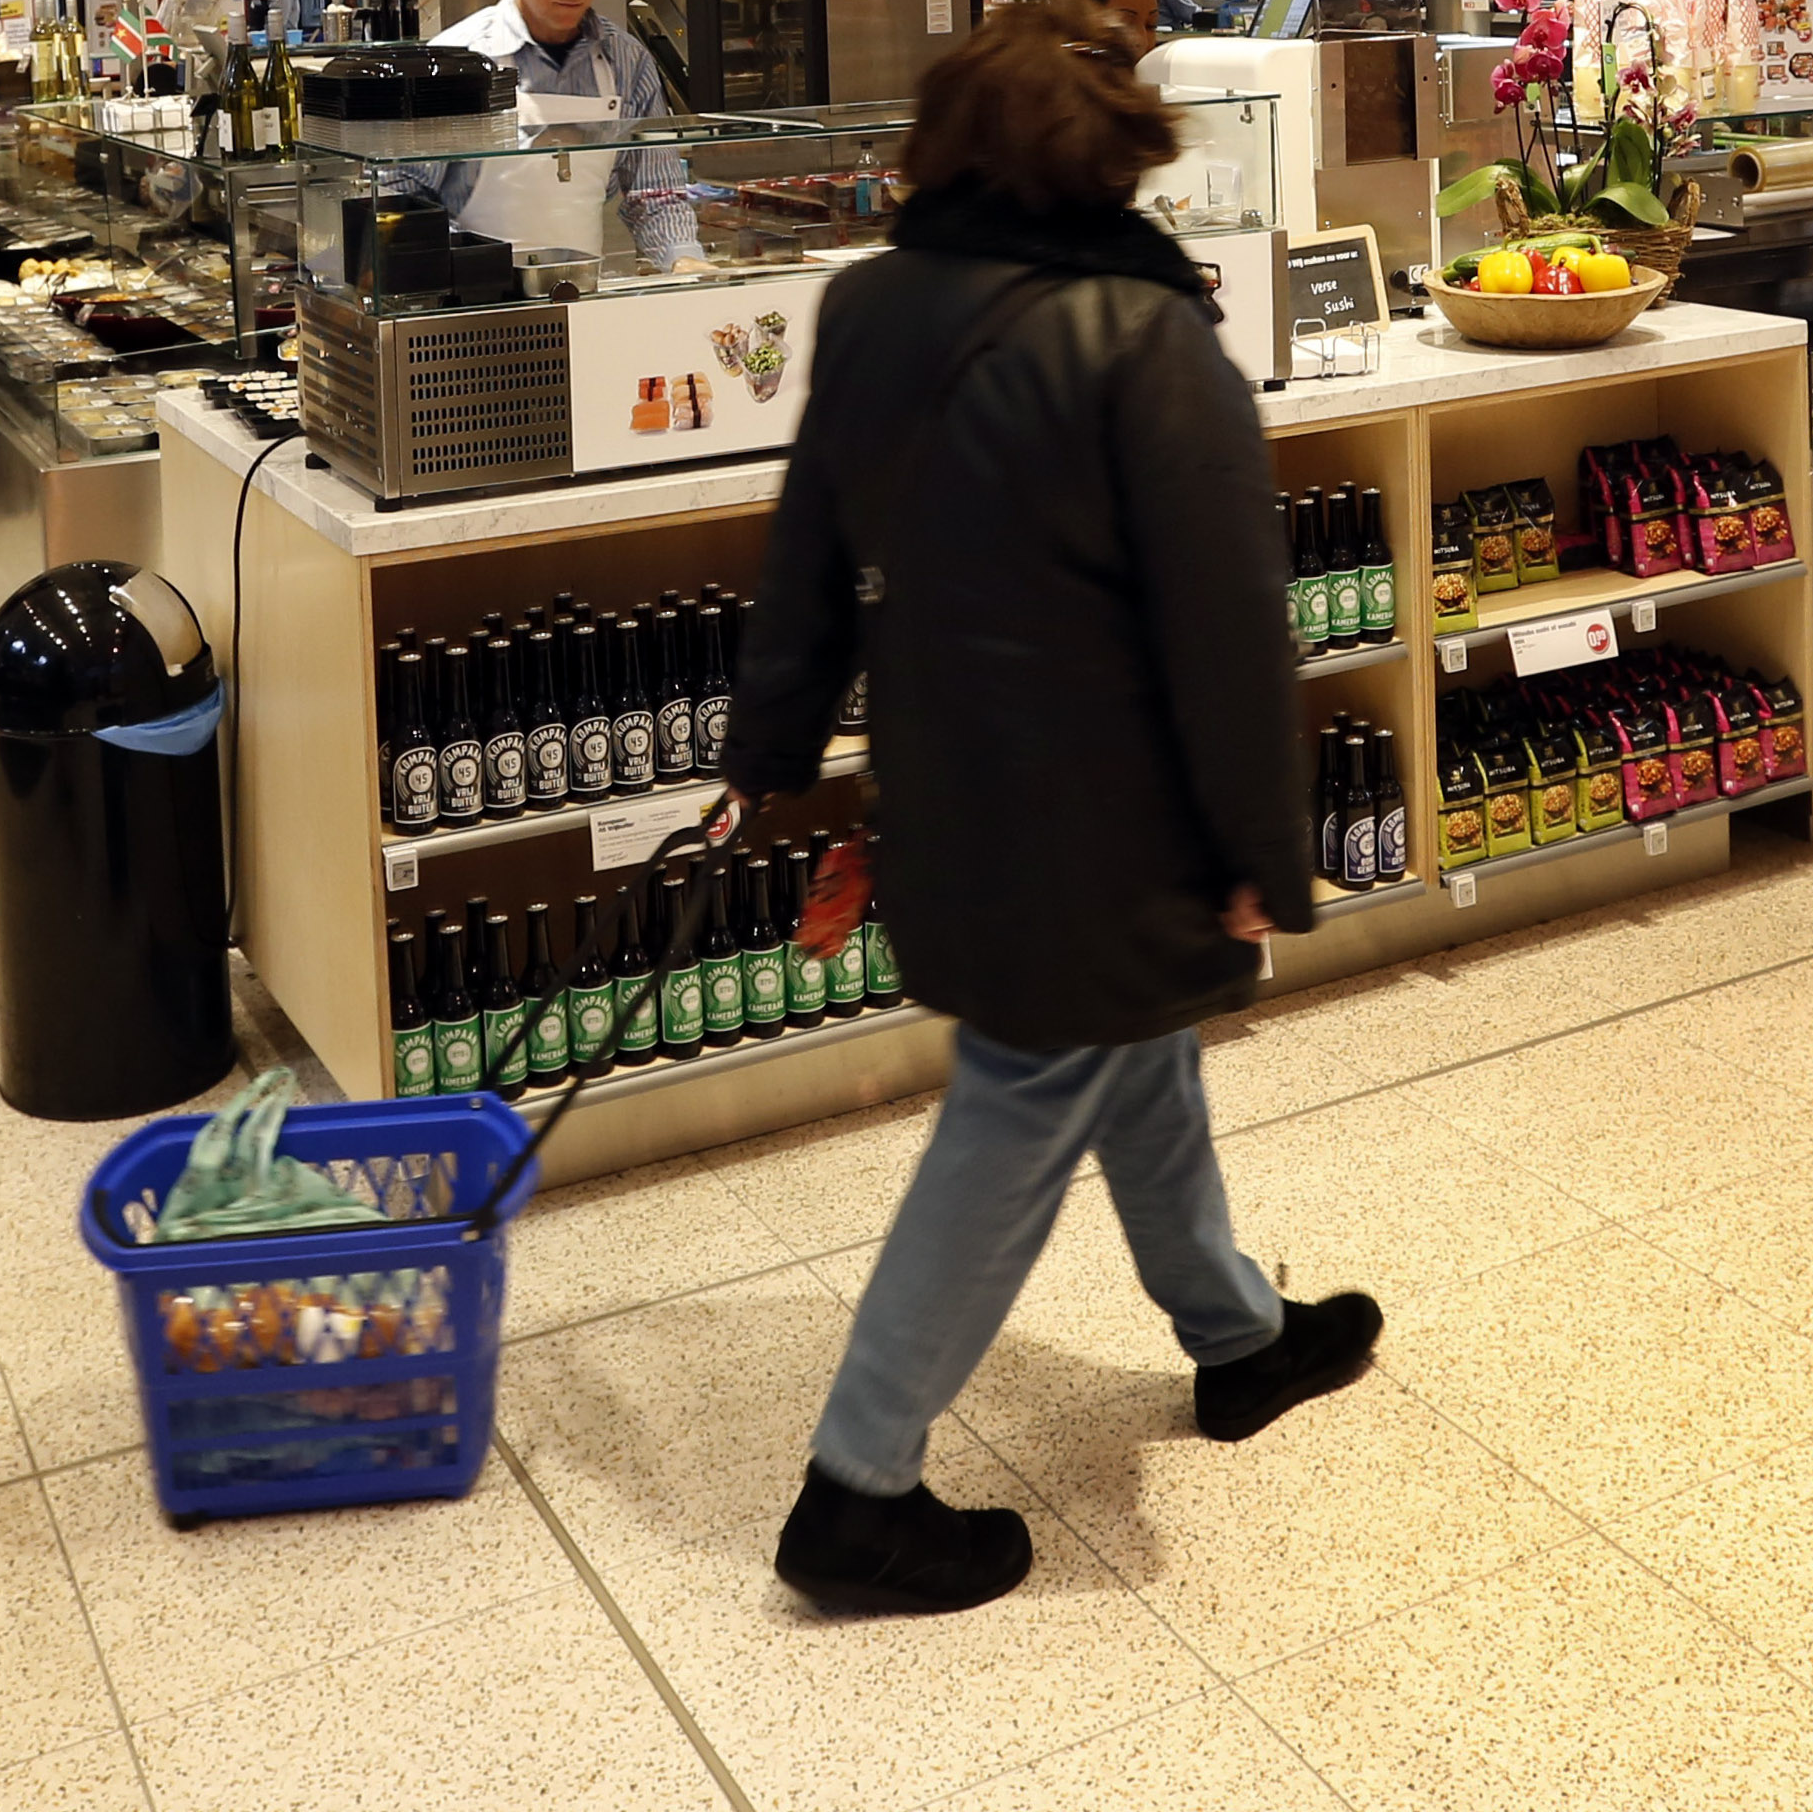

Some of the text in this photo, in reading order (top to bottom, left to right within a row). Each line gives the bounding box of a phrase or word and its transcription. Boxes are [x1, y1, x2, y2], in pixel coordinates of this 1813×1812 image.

[1304, 255, 1326, 266] maken
[1336, 252, 1350, 260] voor
[676, 723, 688, 734] 45
[713, 720, 726, 732] 45
[590, 742, 602, 753] 45
[630, 736, 643, 747] 45
[545, 748, 559, 760] 45
[503, 757, 517, 769] 45
[458, 766, 472, 778] 45
[415, 774, 428, 785] 45
